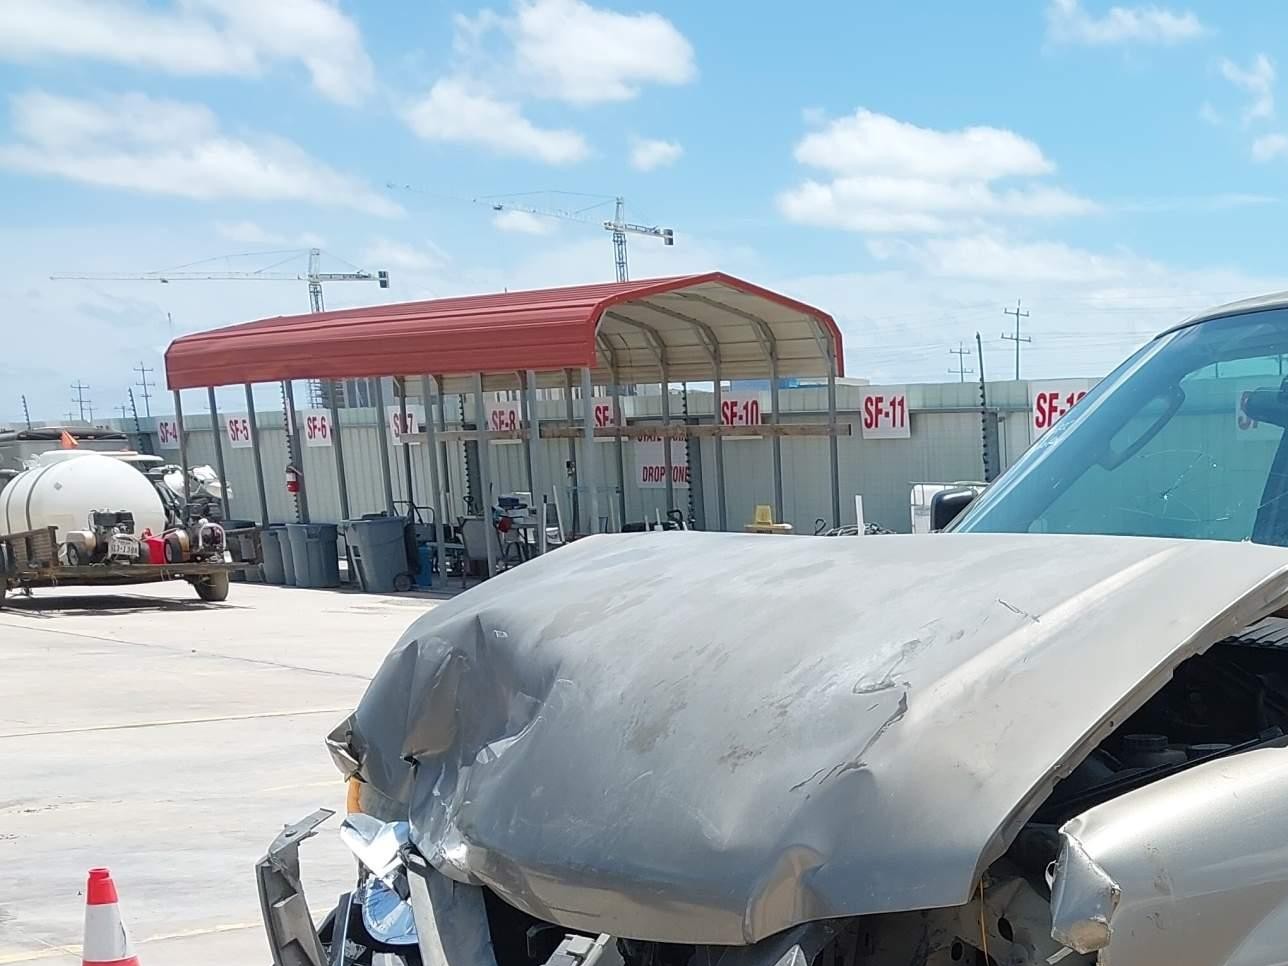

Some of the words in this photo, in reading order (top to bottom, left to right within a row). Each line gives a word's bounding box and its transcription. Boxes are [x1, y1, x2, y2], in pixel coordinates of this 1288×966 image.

[491, 410, 516, 431] SF-8
[864, 396, 904, 429] SF-11
[160, 422, 178, 443] SF-4
[229, 420, 249, 441] SF-5
[307, 416, 327, 439] SF-6
[642, 466, 666, 482] DROP
[671, 466, 689, 482] ONE
